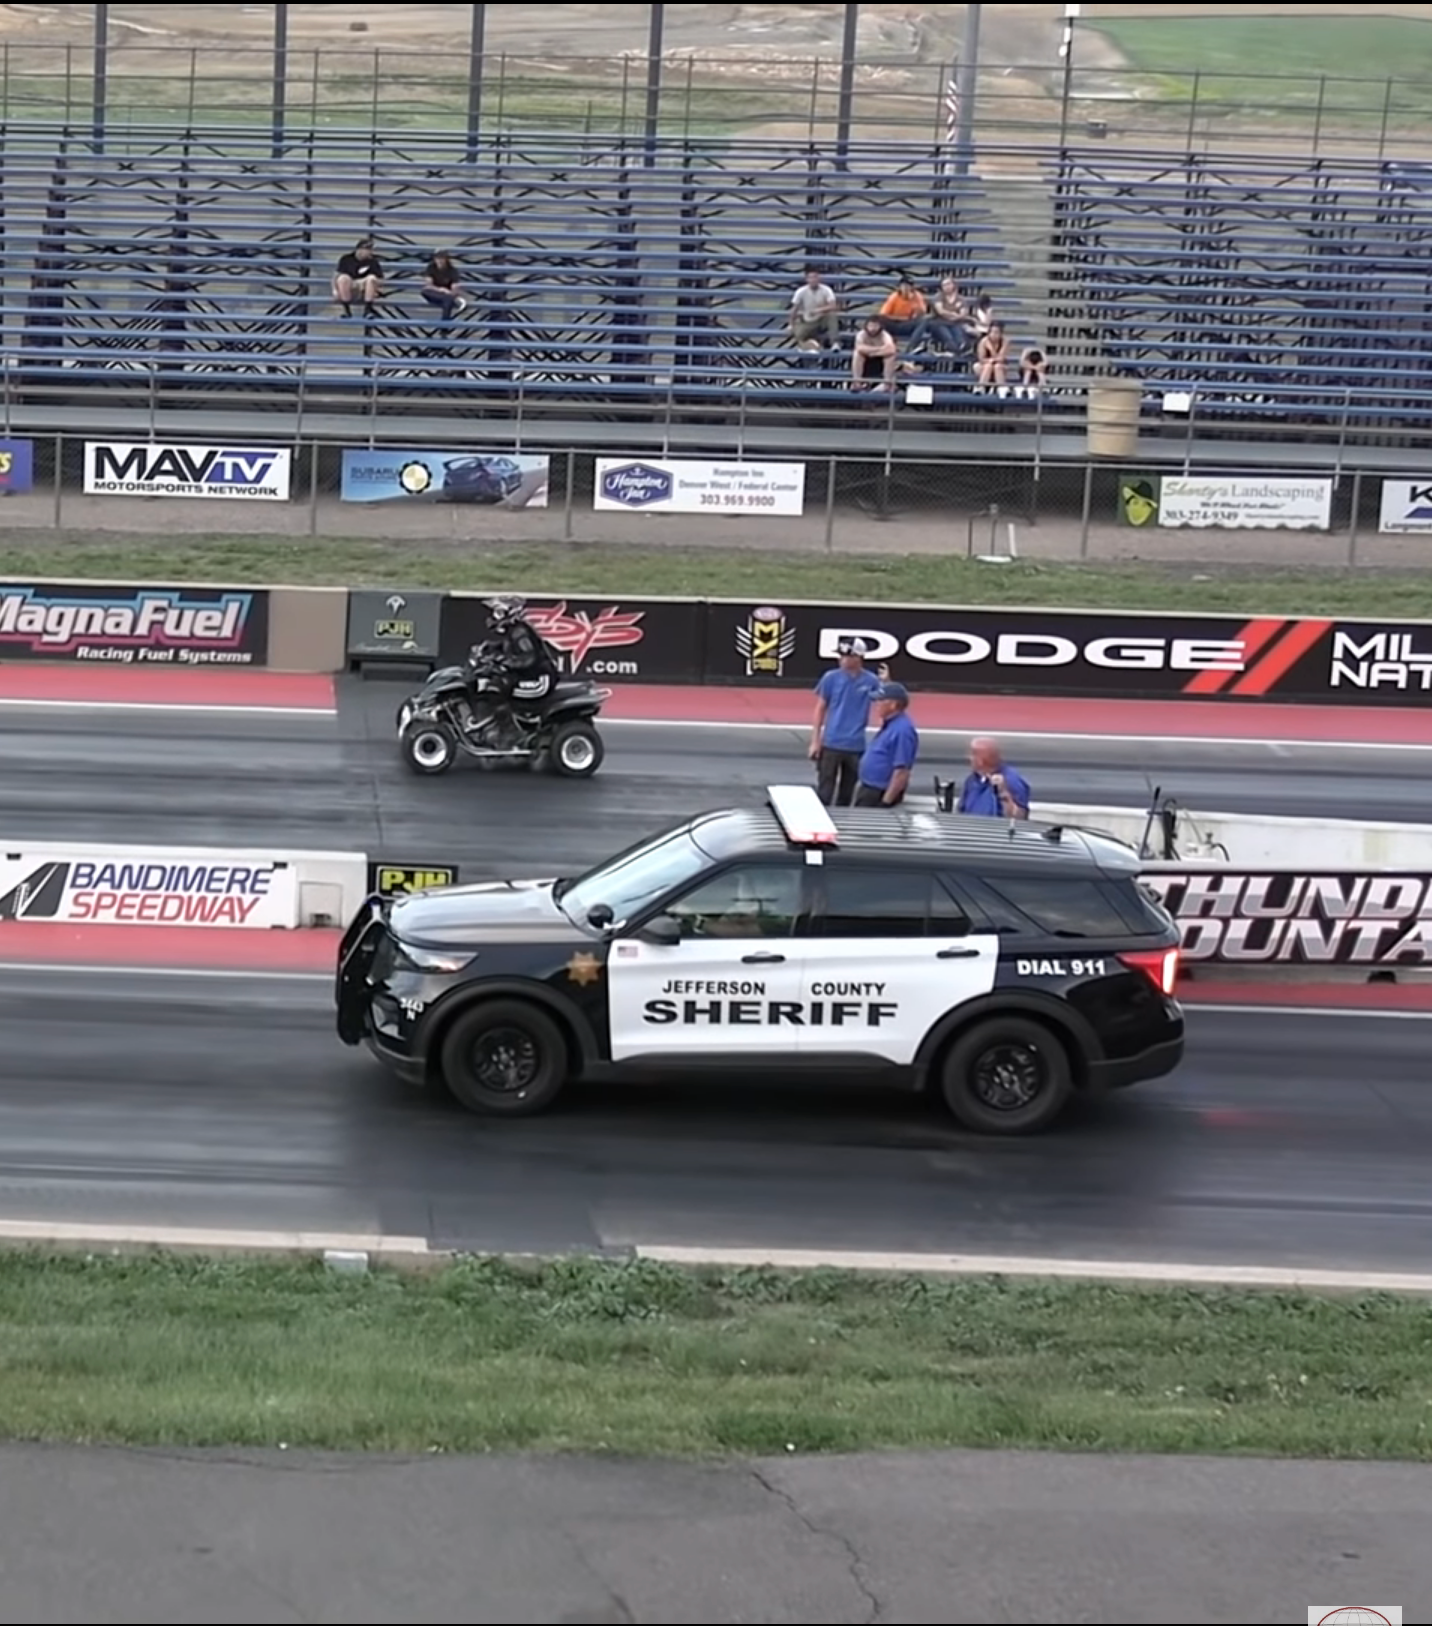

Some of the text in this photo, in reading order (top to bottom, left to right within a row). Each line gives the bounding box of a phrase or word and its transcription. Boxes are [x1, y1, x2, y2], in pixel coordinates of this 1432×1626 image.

[606, 473, 668, 491] Hampton
[713, 468, 749, 479] Hampton
[94, 481, 279, 496] MOTORSPORTS NETWORK
[620, 487, 651, 502] Inn
[679, 479, 707, 489] Denver
[709, 480, 731, 490] West
[738, 481, 769, 491] Federal
[770, 482, 798, 492] Center
[1231, 484, 1325, 503] Landscaping
[77, 646, 252, 665] Racing Fuel Systems
[818, 628, 1247, 672] DODGE
[69, 862, 273, 895] BANDIMERE
[1134, 875, 1432, 919] THUND
[69, 891, 261, 924] SPEEDWAY
[1176, 918, 1432, 961] OUNTA
[1017, 960, 1106, 976] DIAL 911
[663, 980, 887, 997] JEFFERSON COUNTY
[642, 1000, 899, 1027] SHERIFF
